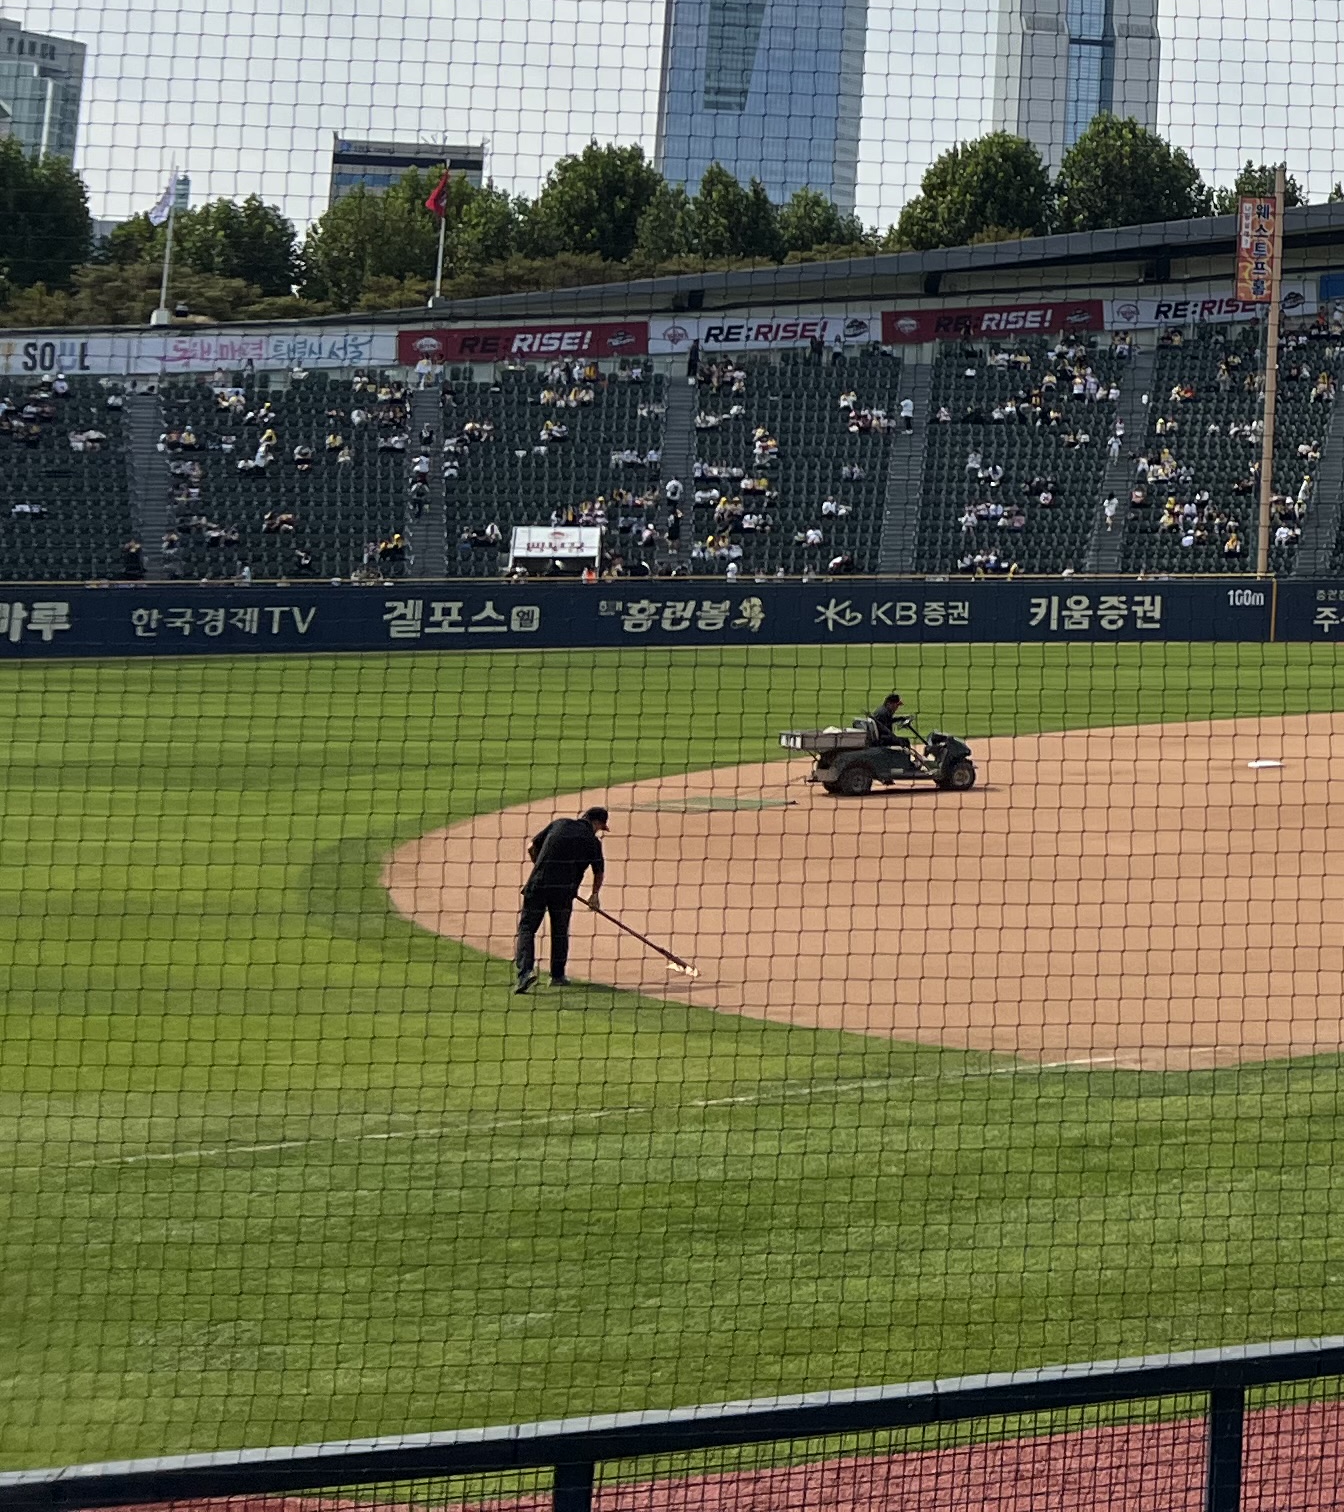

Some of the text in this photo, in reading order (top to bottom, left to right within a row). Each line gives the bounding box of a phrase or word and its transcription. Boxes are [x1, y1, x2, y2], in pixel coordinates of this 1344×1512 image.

[1154, 298, 1257, 319] RE:RISE
[458, 330, 592, 355] RE:RISE!
[704, 320, 829, 344] RE:RISE!
[1227, 589, 1265, 606] 100m
[131, 606, 317, 637] 한국경제TV
[621, 600, 731, 634] 홈런볼
[870, 600, 970, 627] KB 증권
[1029, 595, 1163, 631] 키움증권
